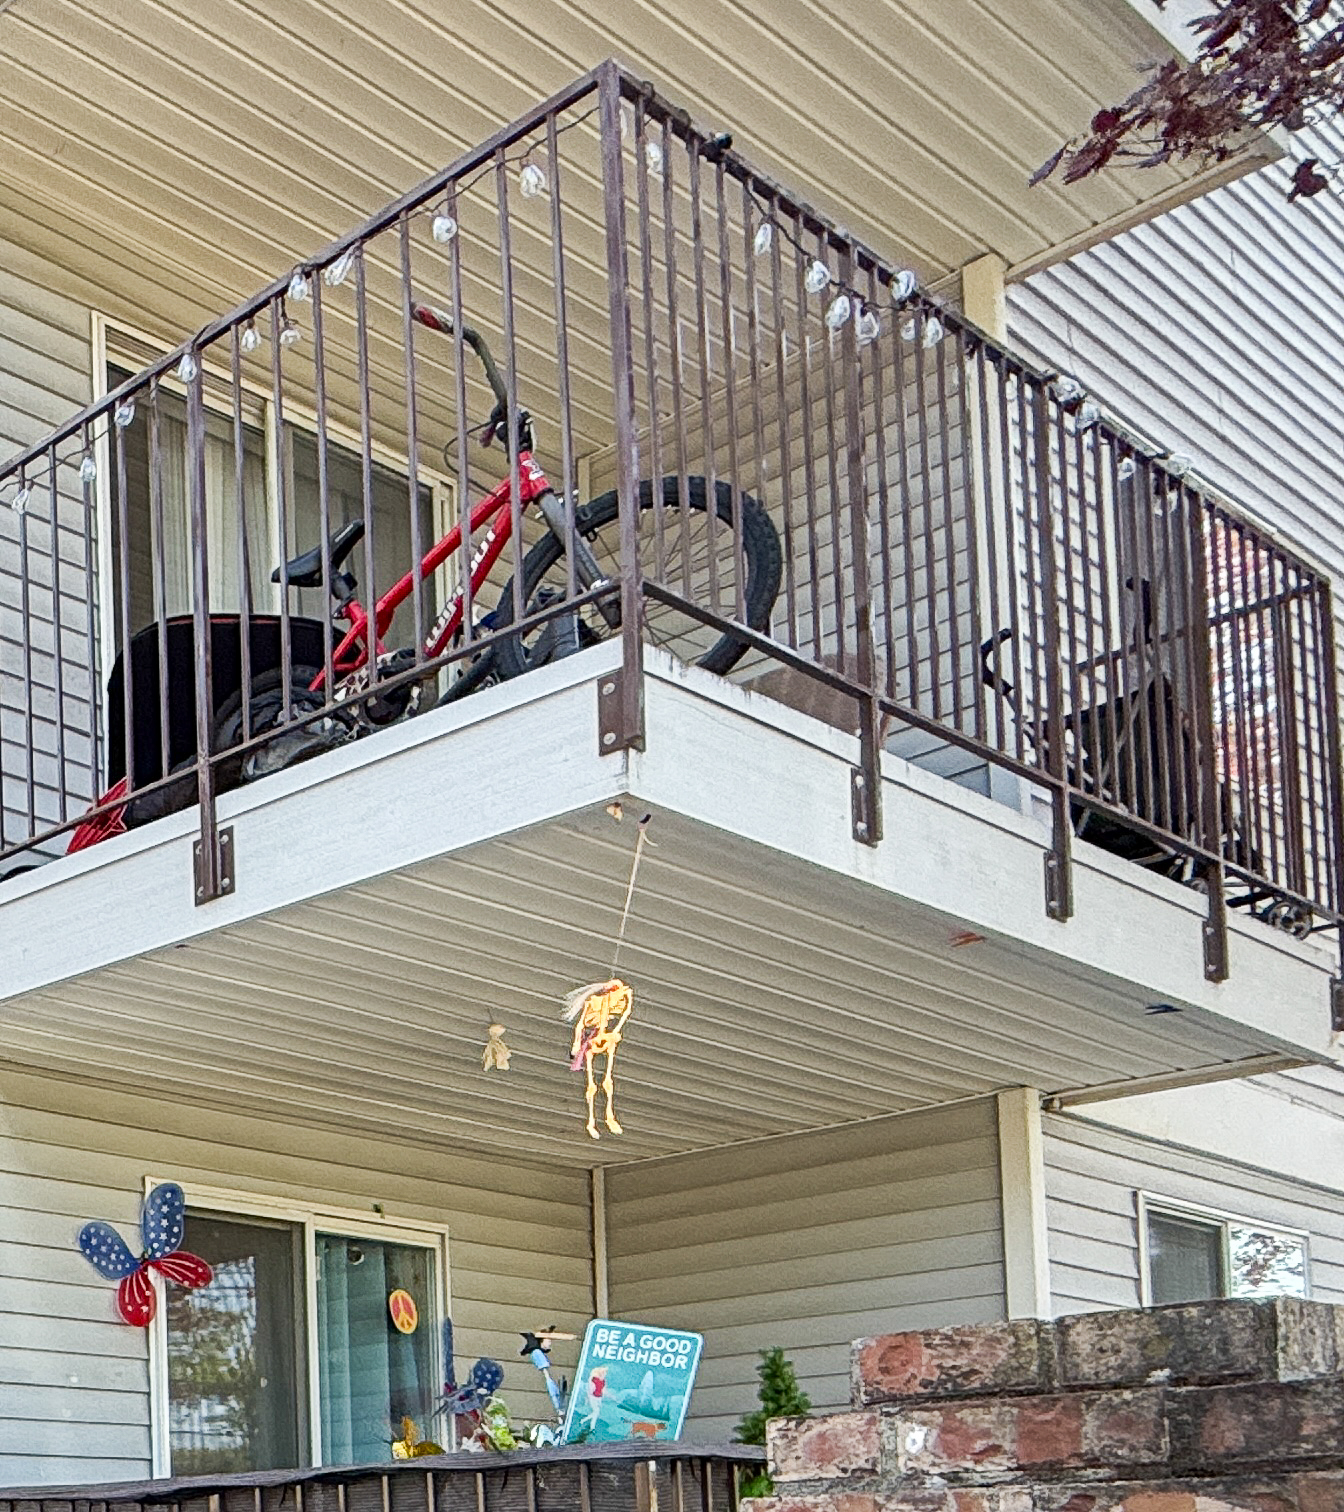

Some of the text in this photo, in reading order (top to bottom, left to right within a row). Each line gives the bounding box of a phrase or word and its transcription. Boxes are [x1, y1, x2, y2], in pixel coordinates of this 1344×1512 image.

[596, 1328, 692, 1355] BE A GOOD
[592, 1344, 688, 1369] NEIGHBOR
